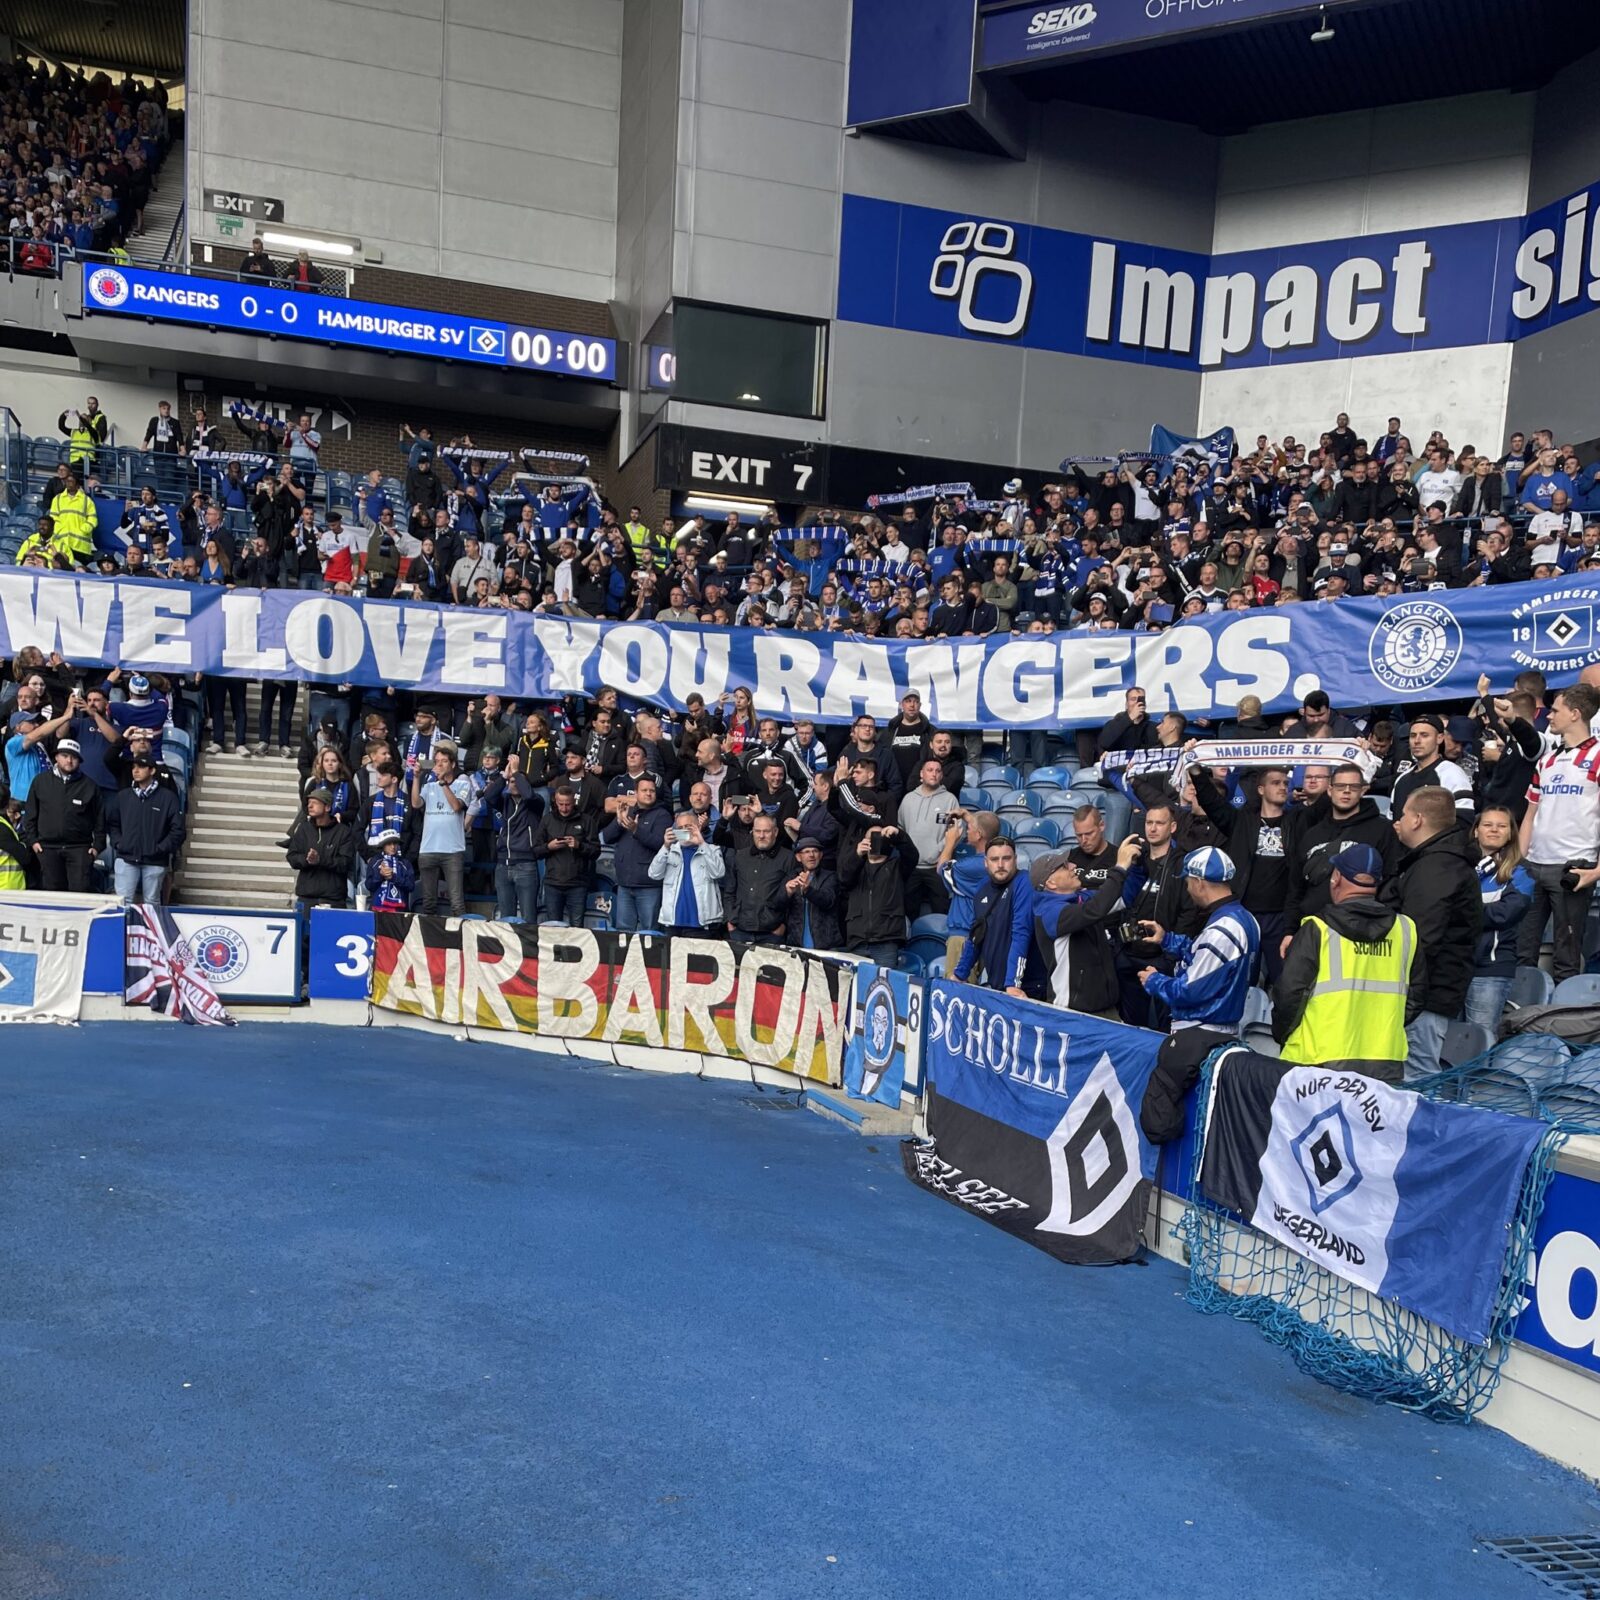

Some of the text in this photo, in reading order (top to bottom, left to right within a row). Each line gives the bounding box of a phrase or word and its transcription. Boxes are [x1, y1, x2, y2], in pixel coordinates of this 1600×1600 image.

[1027, 3, 1097, 34] SEKO
[213, 194, 275, 216] EXIT 7
[1086, 191, 1600, 365] Impact si
[133, 284, 220, 309] RANGERS
[241, 296, 258, 317] 0
[281, 302, 298, 323] 0
[318, 309, 436, 342] HAMBURGER
[440, 327, 464, 345] SV
[511, 331, 606, 373] 00:00
[305, 406, 322, 428] 7
[442, 447, 510, 460] RANGERS
[523, 449, 585, 462] GLASGOW
[691, 451, 813, 491] EXIT 7
[1511, 589, 1598, 619] HAMBURGER
[1381, 605, 1451, 632] RANGERS
[1512, 627, 1530, 643] 18
[0, 574, 1321, 722] WE LOVE YOU RANGERS.
[1510, 650, 1584, 671] SUPPORTERS
[1374, 649, 1456, 688] FOOTBALL CLUB
[1215, 744, 1322, 757] HAMBURGER S.V.
[1540, 784, 1584, 796] YUNDAI
[0, 923, 80, 947] CLUB
[195, 928, 243, 948] RANGERS
[266, 924, 288, 955] 7
[1353, 938, 1393, 957] SECURITY
[226, 962, 244, 979] CLUB
[908, 992, 920, 1032] 8
[928, 988, 1070, 1099] SCHOLLI
[1296, 1076, 1385, 1132] NUR DER HSV
